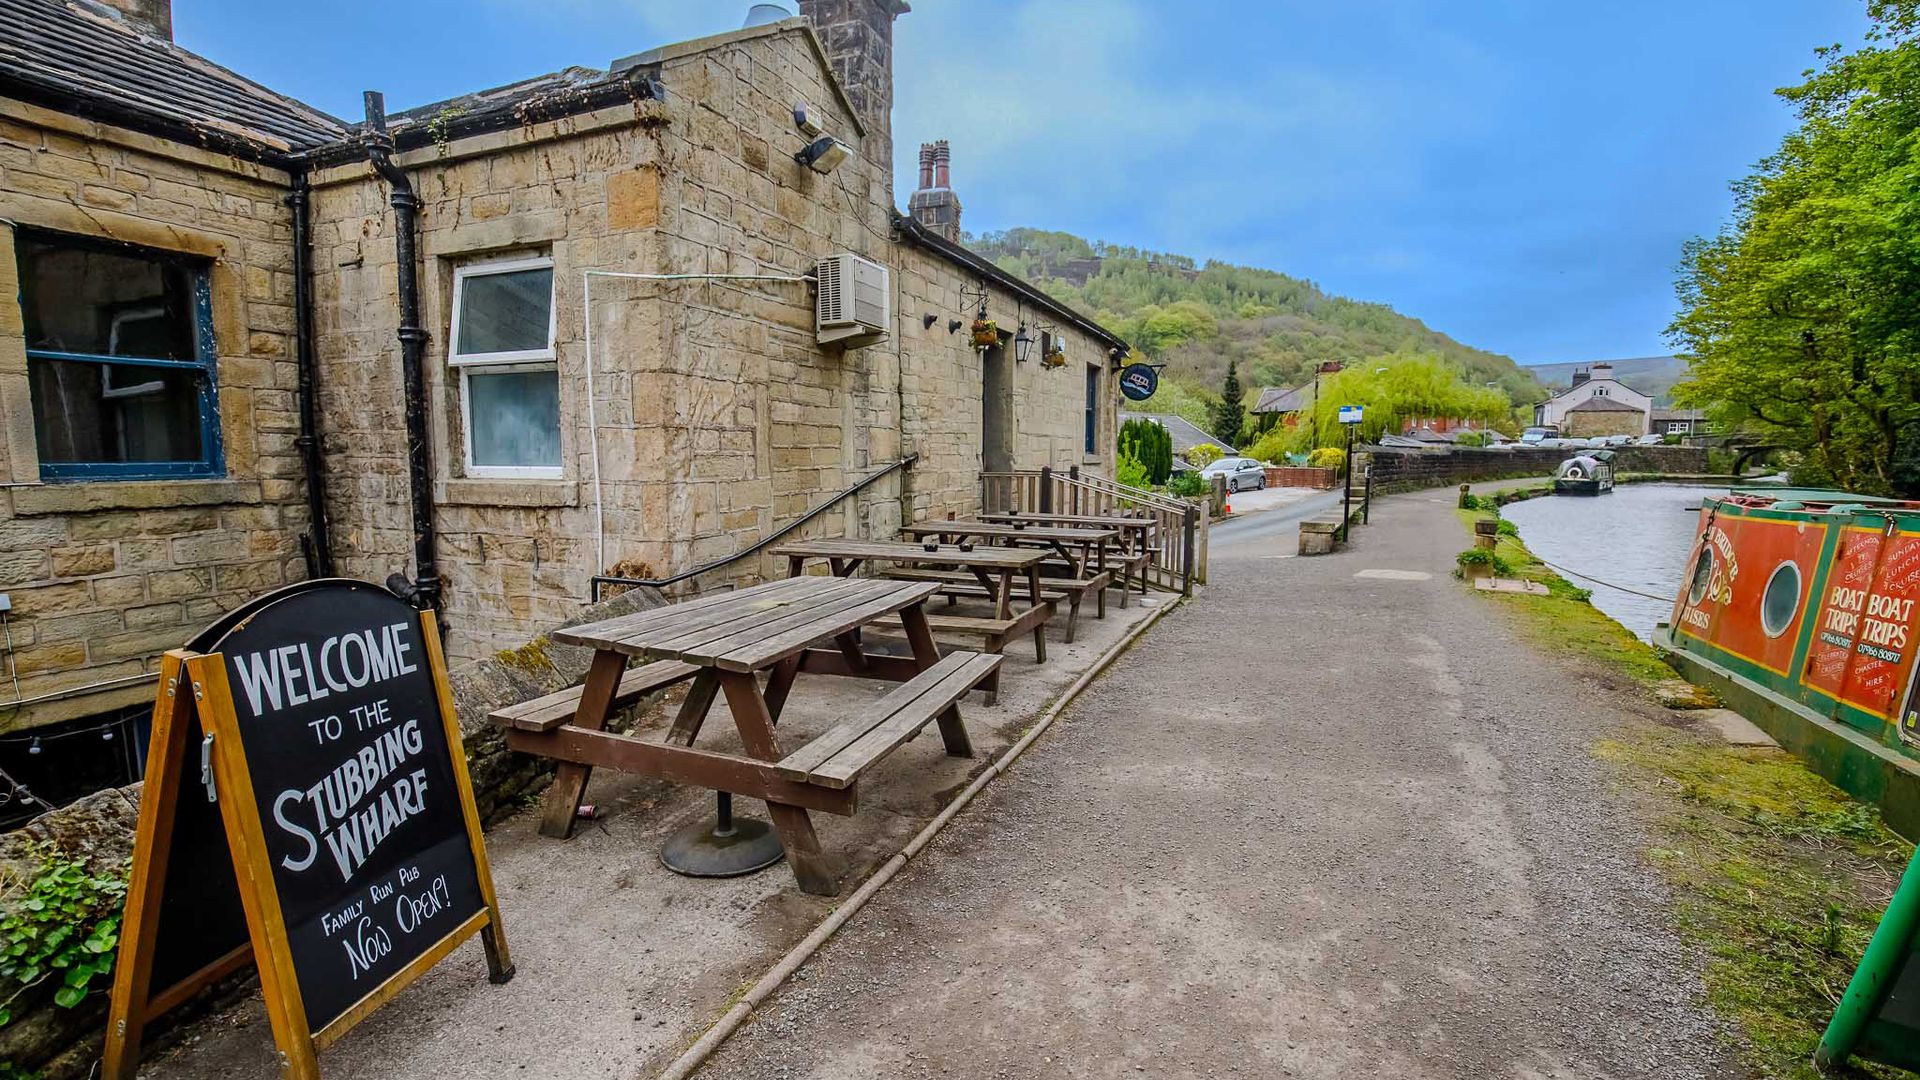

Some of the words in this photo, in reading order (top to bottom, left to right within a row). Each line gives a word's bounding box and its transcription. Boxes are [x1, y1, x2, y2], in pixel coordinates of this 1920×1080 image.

[1886, 554, 1919, 579] LUNCH
[1830, 586, 1866, 611] BOAT
[1867, 594, 1914, 622] BOAT
[1679, 604, 1711, 629] UISES
[1825, 607, 1860, 636] TRIPS
[1861, 618, 1909, 648] TRIPS
[233, 622, 417, 717] WELCOME
[1865, 676, 1884, 687] HIRE
[308, 715, 342, 745] TO
[349, 699, 391, 731] THE
[273, 719, 423, 872] STUBBING
[324, 768, 428, 883] WHARF
[321, 900, 363, 936] FAMILY
